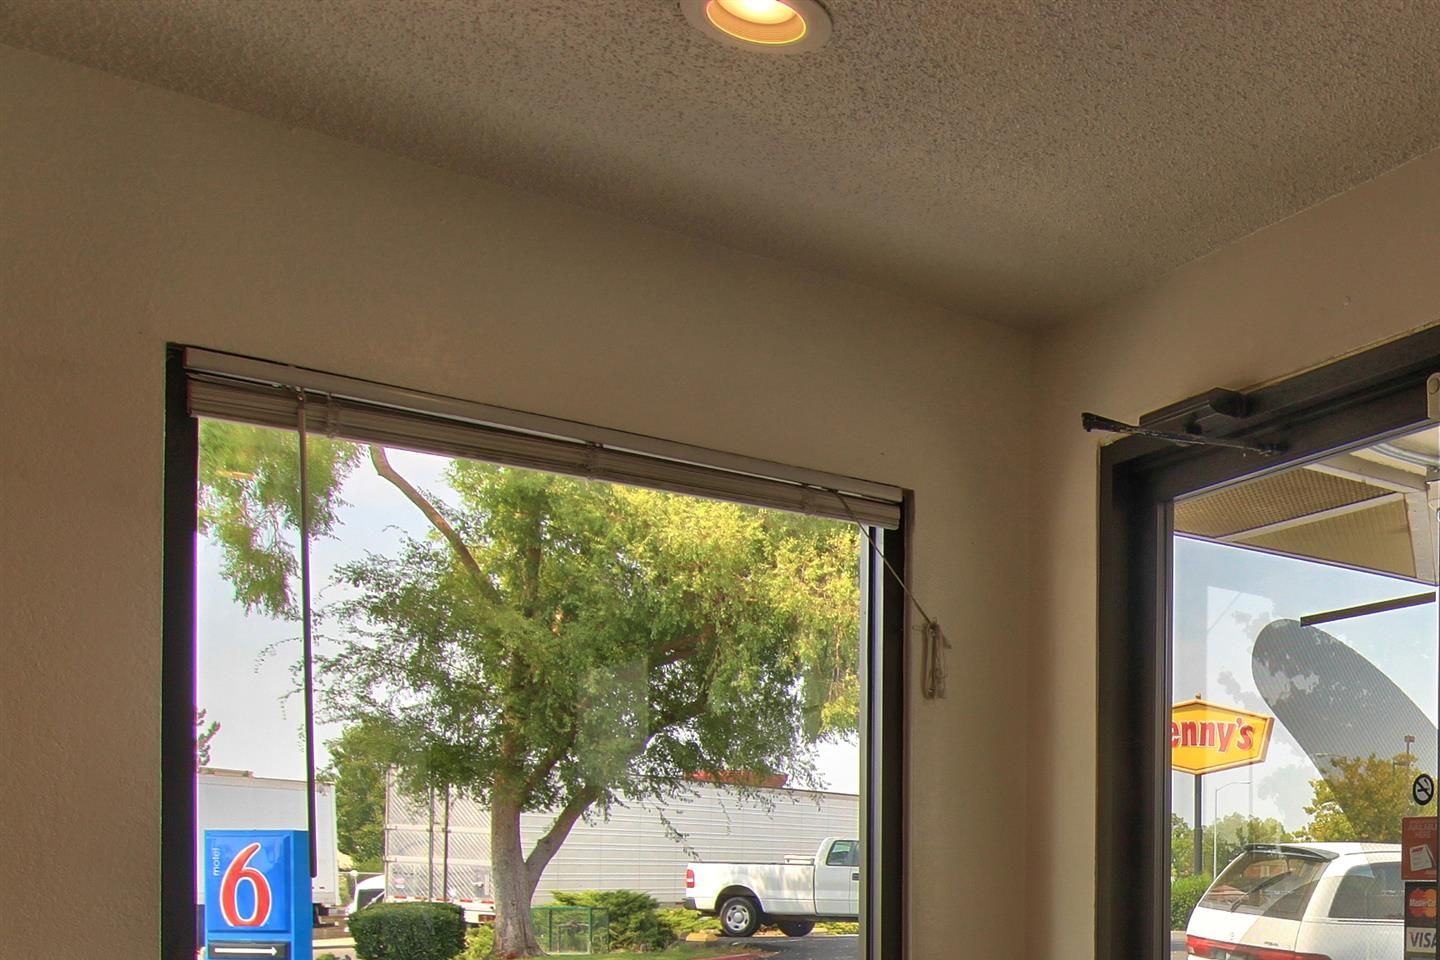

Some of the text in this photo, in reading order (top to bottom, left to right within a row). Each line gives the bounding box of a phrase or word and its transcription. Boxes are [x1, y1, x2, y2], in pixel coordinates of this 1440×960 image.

[1172, 717, 1254, 752] enny's
[212, 847, 221, 877] motel
[219, 842, 272, 928] 6
